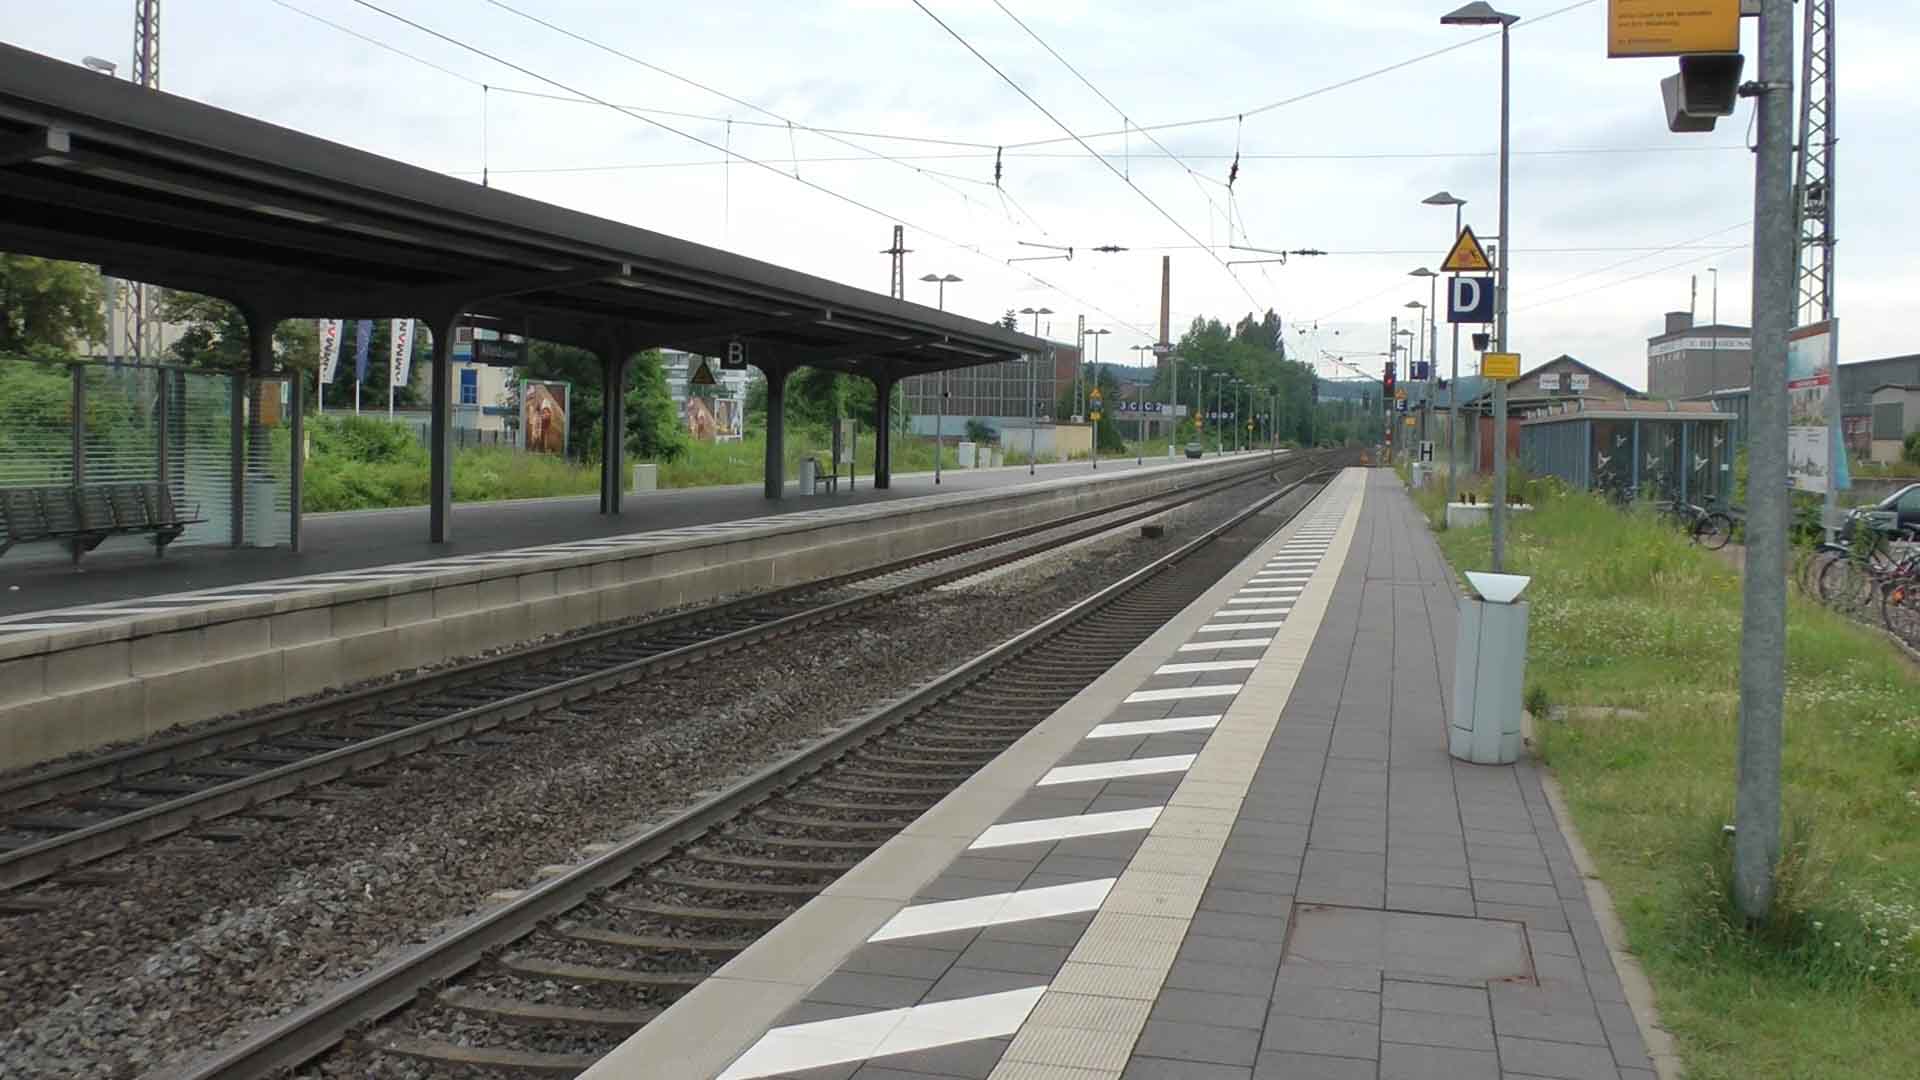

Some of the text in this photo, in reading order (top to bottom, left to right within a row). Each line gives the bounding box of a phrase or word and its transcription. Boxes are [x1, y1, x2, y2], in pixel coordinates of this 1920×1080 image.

[1454, 278, 1480, 312] D
[728, 344, 744, 363] B
[1411, 362, 1418, 376] 1
[1144, 402, 1152, 410] C
[1397, 400, 1404, 409] E
[1421, 443, 1433, 461] H
